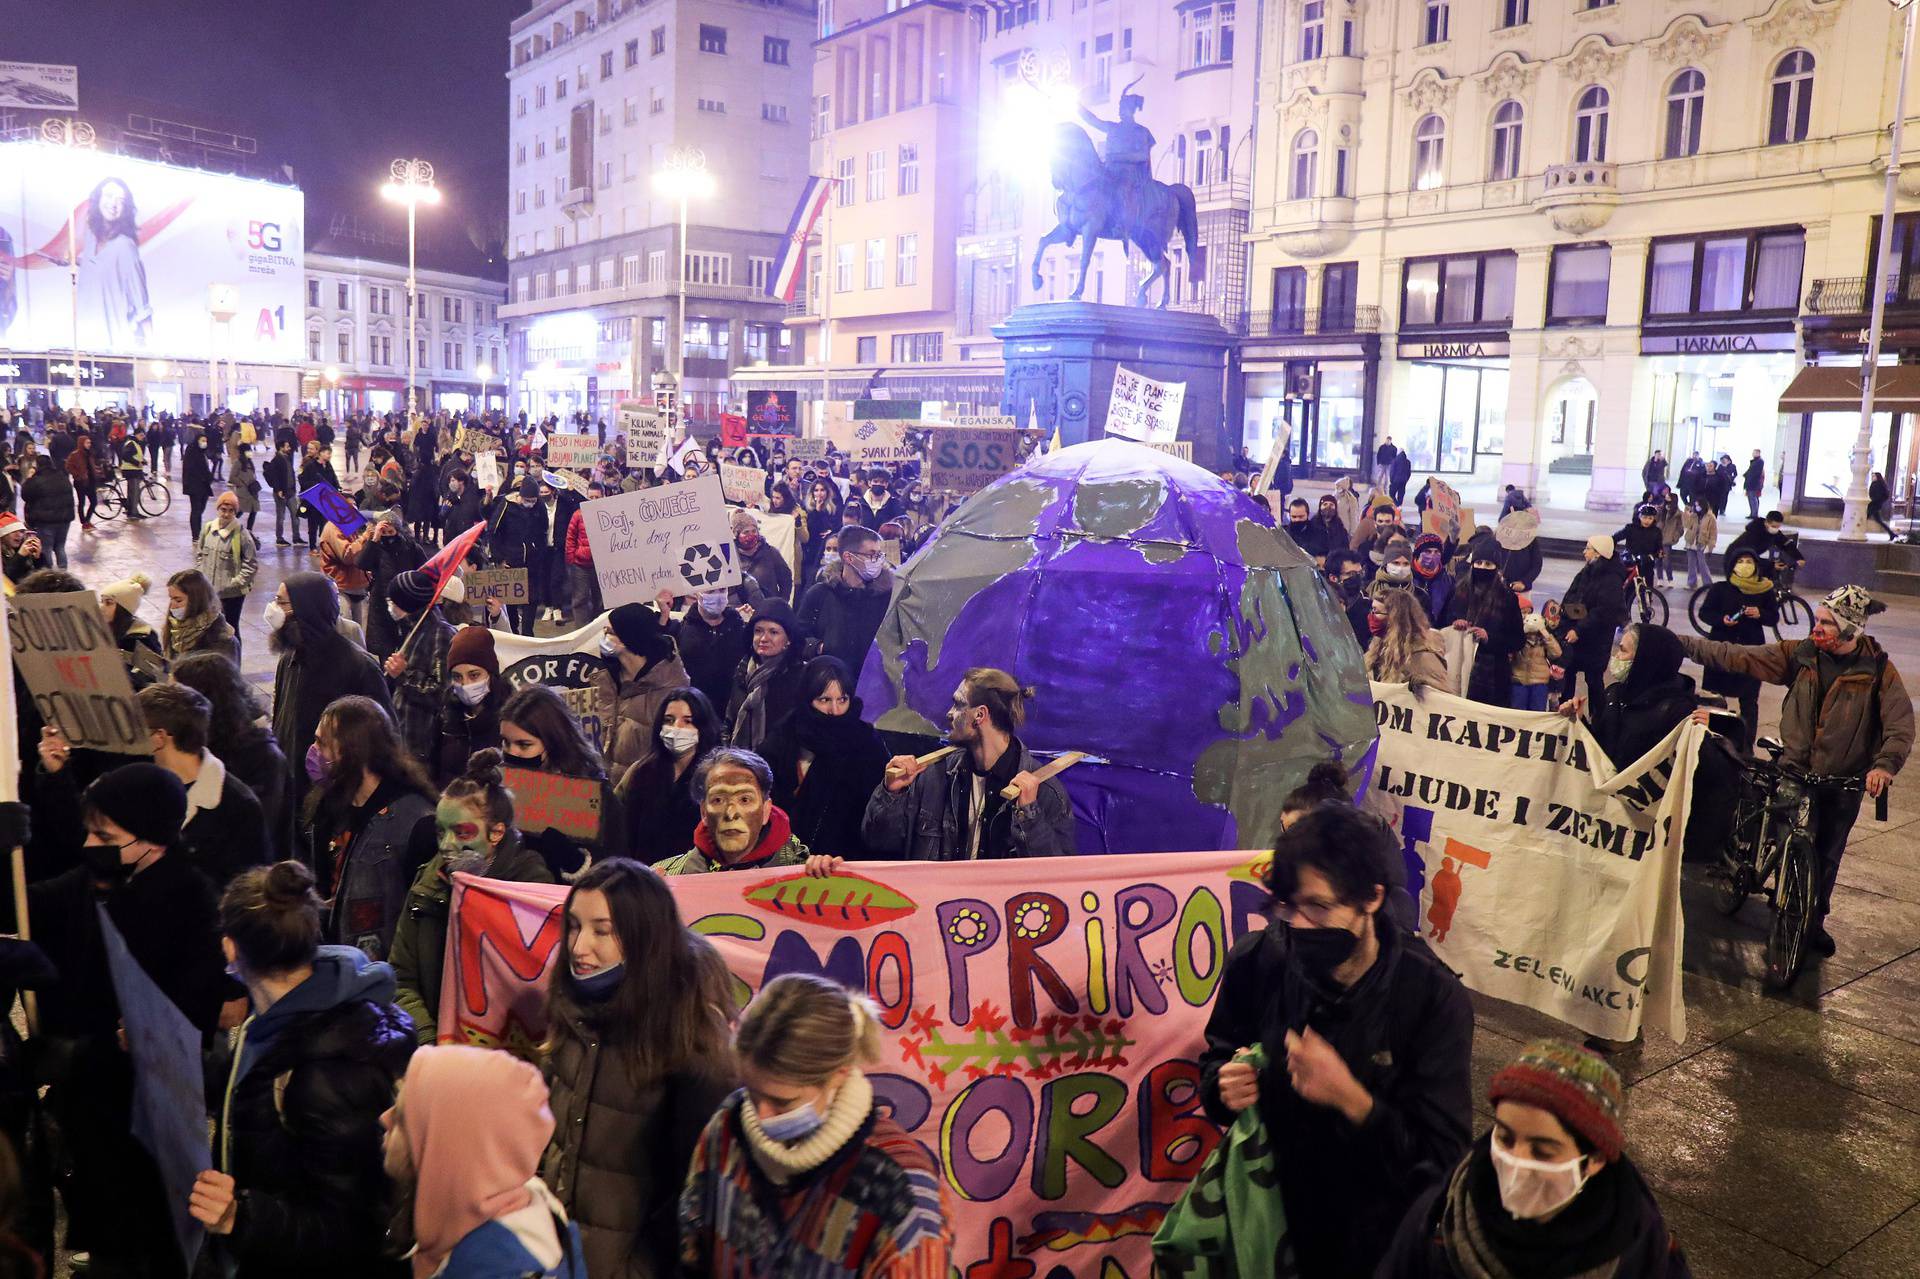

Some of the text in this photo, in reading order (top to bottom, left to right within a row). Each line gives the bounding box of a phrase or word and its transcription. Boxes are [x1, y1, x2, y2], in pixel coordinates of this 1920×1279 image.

[247, 219, 282, 252] 5G
[248, 254, 295, 267] gigaBITNA
[256, 305, 284, 341] A1
[1424, 343, 1486, 358] HARMICA
[1675, 336, 1758, 352] HARMICA
[630, 429, 641, 437] THE
[628, 439, 635, 448] IS
[861, 446, 890, 458] SVAKI
[1146, 442, 1189, 462] EGANI
[628, 451, 640, 461] THE
[936, 440, 1008, 471] S.O.S.
[638, 490, 701, 523] ČOVJEČE
[646, 528, 671, 554] drag
[467, 582, 526, 600] PLANET B
[509, 659, 559, 692] FOR
[1377, 764, 1501, 821] LJUDE
[1512, 796, 1532, 827] I
